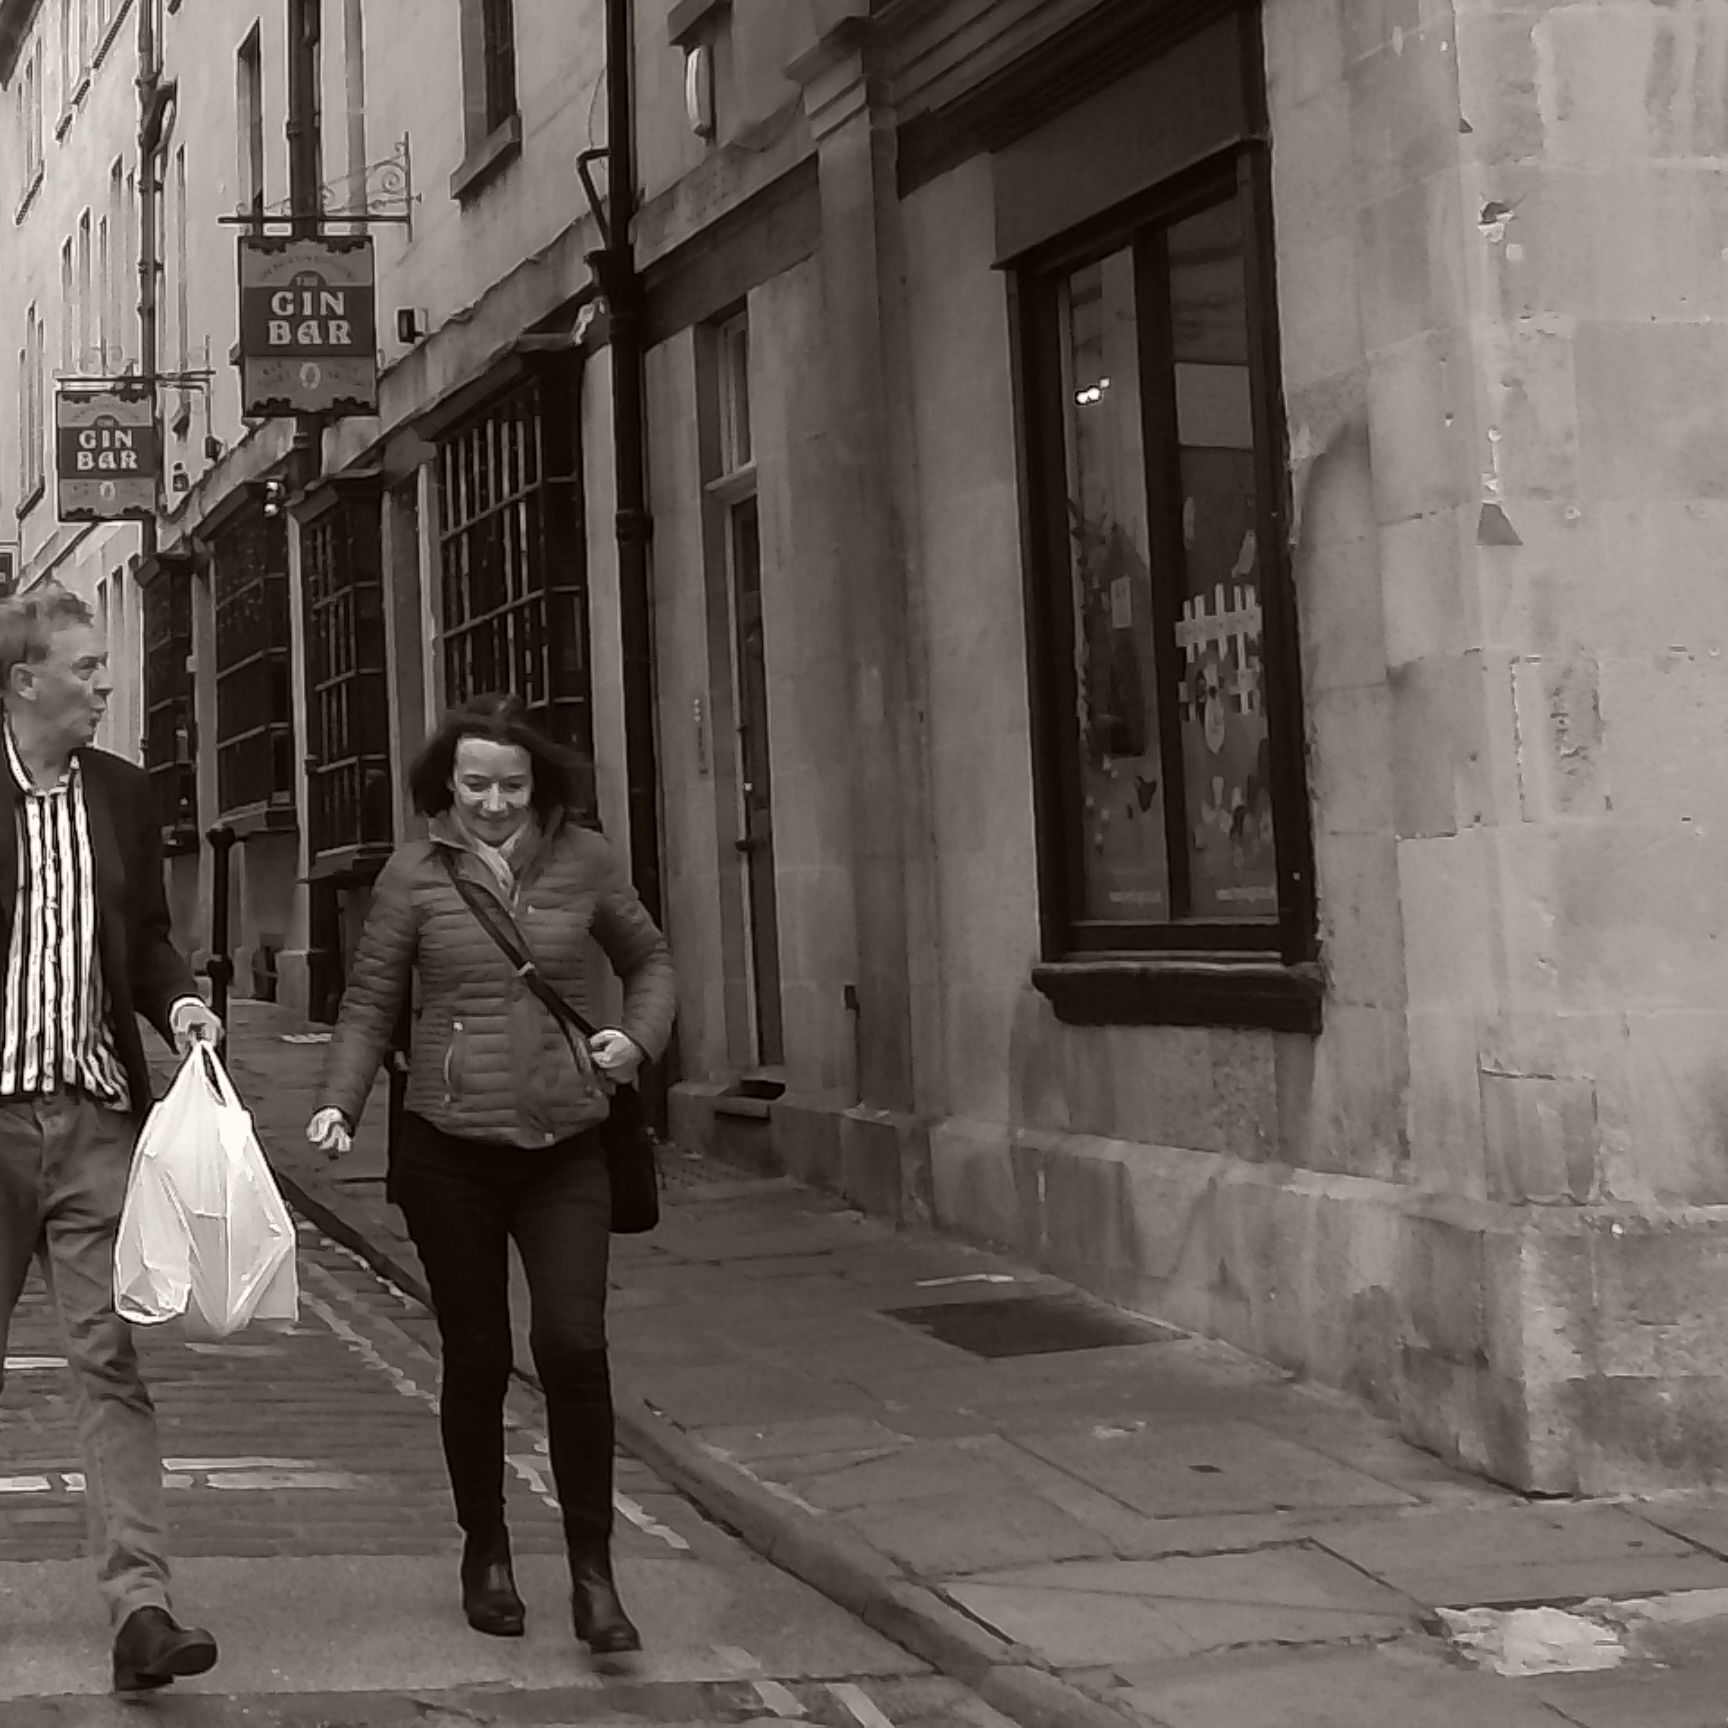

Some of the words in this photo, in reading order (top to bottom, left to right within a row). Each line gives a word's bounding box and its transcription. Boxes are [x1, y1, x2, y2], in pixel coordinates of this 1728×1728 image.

[271, 291, 345, 316] GIN
[268, 320, 352, 345] BAR
[78, 429, 132, 449] GIN
[76, 450, 138, 470] BAR
